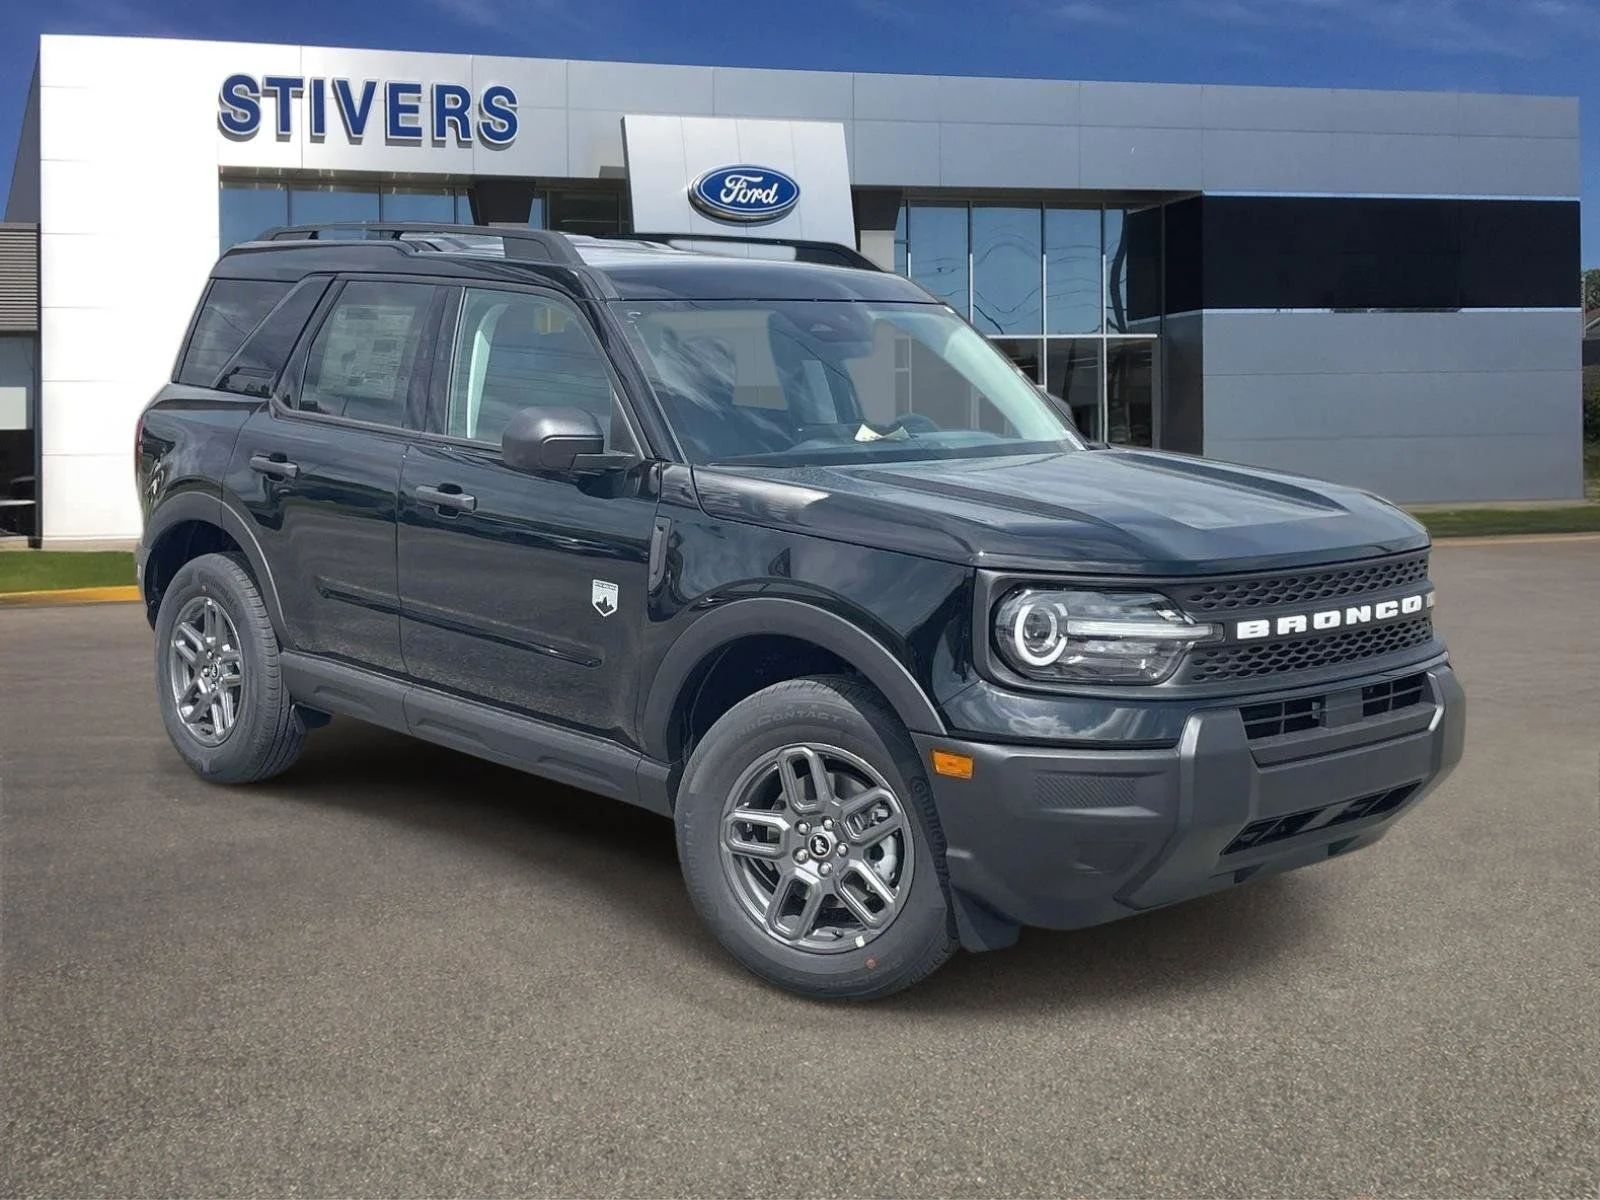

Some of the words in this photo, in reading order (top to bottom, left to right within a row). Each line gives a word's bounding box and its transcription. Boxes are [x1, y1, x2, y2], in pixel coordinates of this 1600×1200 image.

[218, 73, 519, 147] STIVERS
[720, 174, 778, 204] Ford
[1236, 595, 1422, 640] BRONCO
